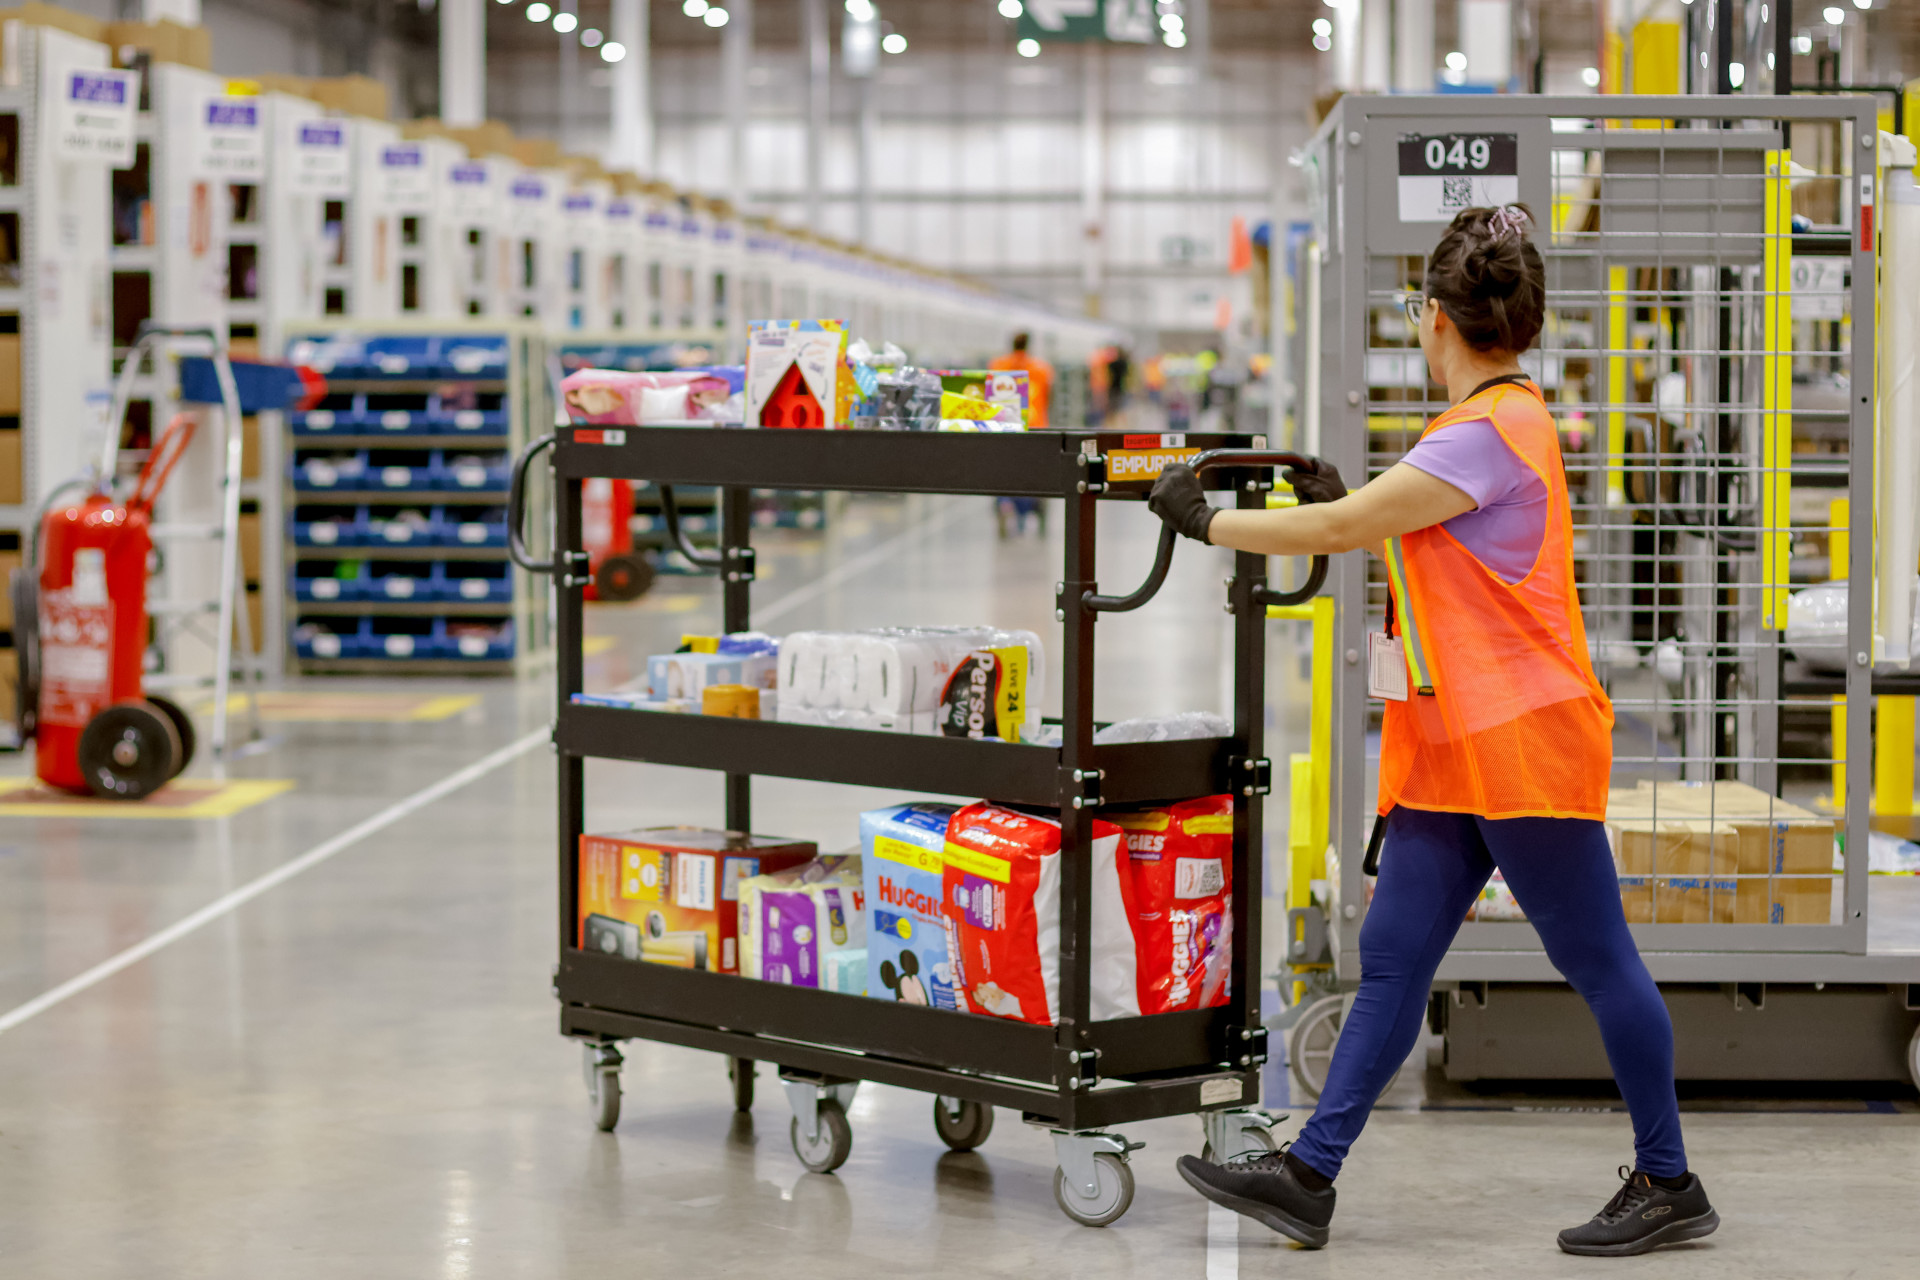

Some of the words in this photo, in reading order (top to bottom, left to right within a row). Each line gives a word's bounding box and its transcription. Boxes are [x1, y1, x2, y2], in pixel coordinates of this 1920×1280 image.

[1425, 139, 1490, 170] 049
[1010, 662, 1018, 688] LEVE
[1008, 691, 1019, 712] 24
[918, 853, 928, 866] G
[1168, 909, 1191, 1008] HUGGIES
